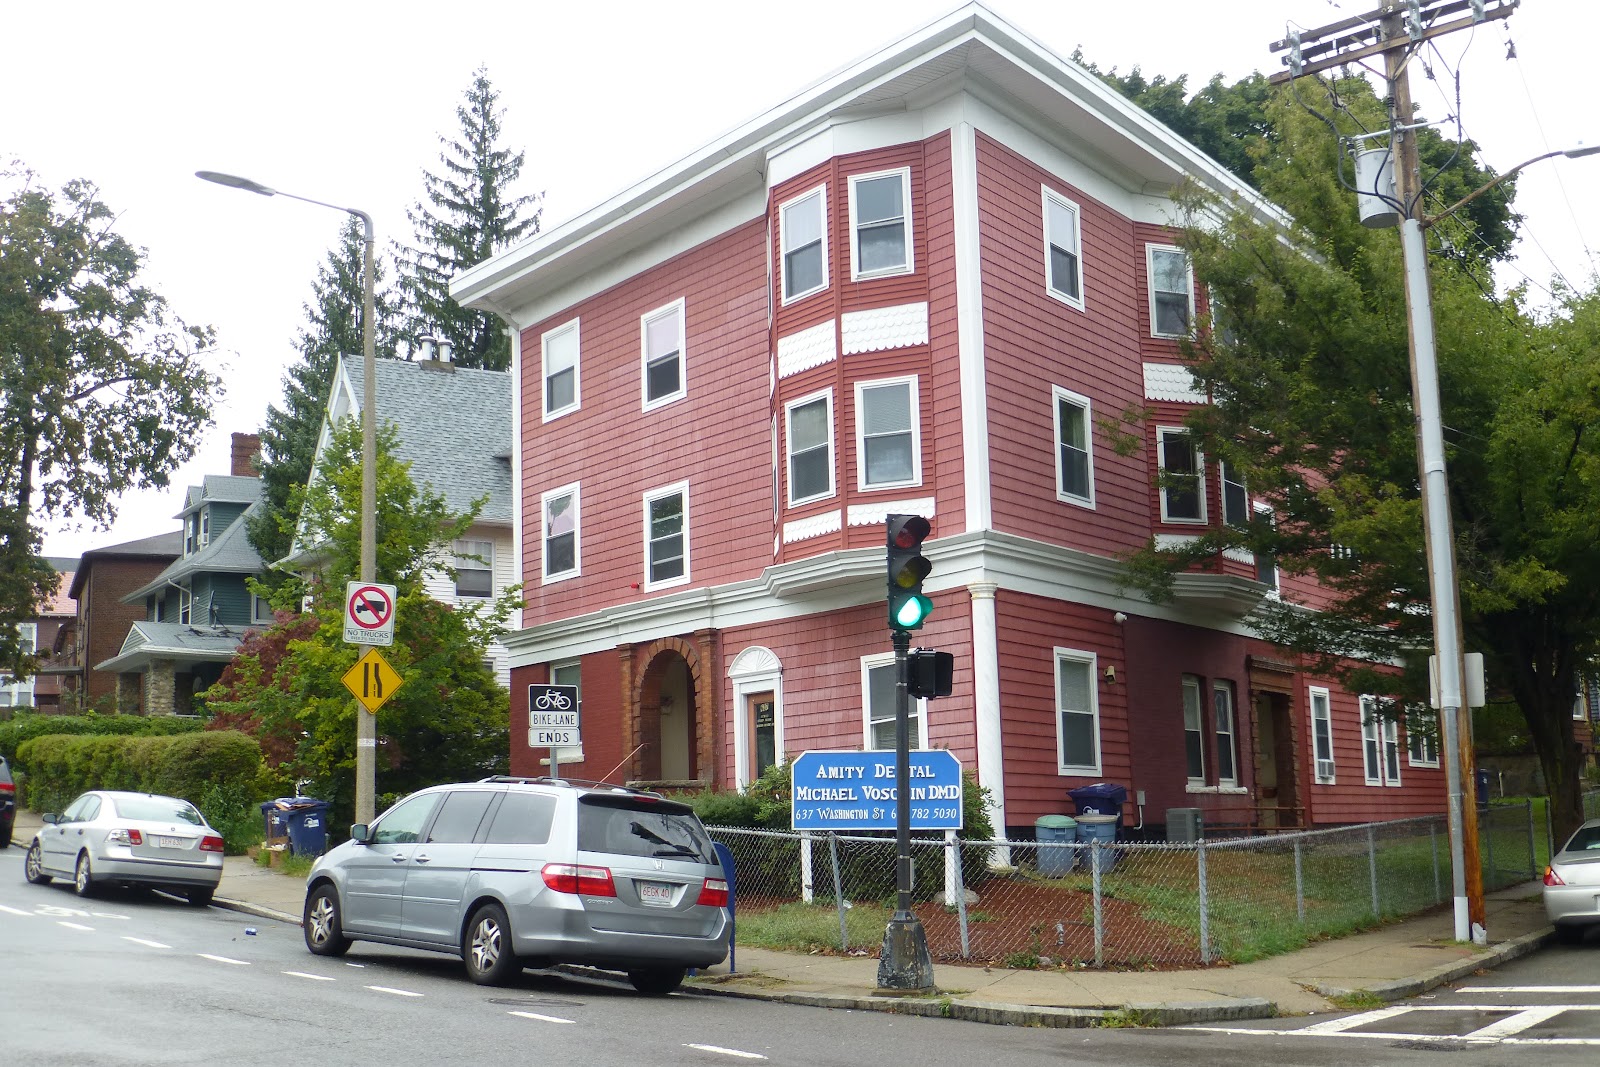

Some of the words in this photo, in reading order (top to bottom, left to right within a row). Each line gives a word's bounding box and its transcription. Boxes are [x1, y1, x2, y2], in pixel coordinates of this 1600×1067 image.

[360, 631, 389, 639] TRUCKS
[534, 714, 552, 724] BIKE
[556, 714, 575, 725] LANE
[539, 732, 569, 742] ENDS
[816, 764, 865, 778] AMITY
[874, 763, 936, 778] DETAL
[796, 786, 858, 800] MICHAEL
[928, 784, 960, 800] DMD
[796, 808, 814, 820] 637
[816, 807, 869, 820] WASHINGTON
[872, 806, 886, 820] ST
[911, 808, 930, 819] 782
[932, 808, 957, 819] 5030
[660, 888, 670, 898] 40
